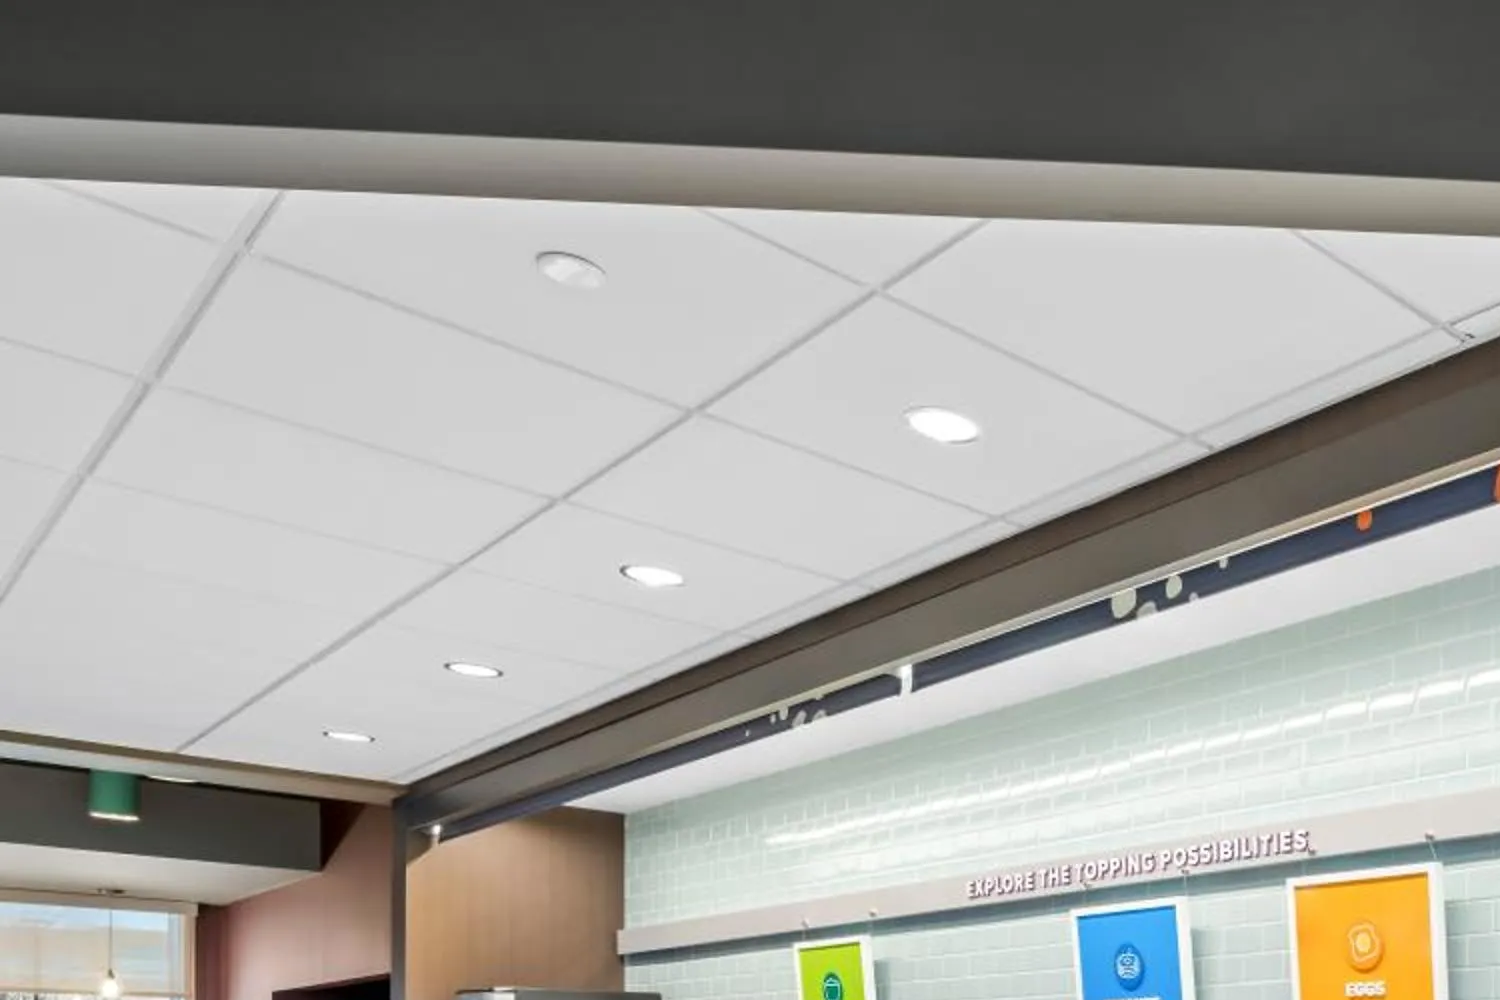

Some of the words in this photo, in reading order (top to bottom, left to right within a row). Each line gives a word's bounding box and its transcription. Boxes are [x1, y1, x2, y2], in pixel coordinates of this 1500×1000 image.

[966, 871, 1034, 899] EXPLORE
[1037, 864, 1072, 889] THE
[1075, 852, 1156, 882] TOPPING
[1160, 829, 1309, 870] POSSIBILITIES
